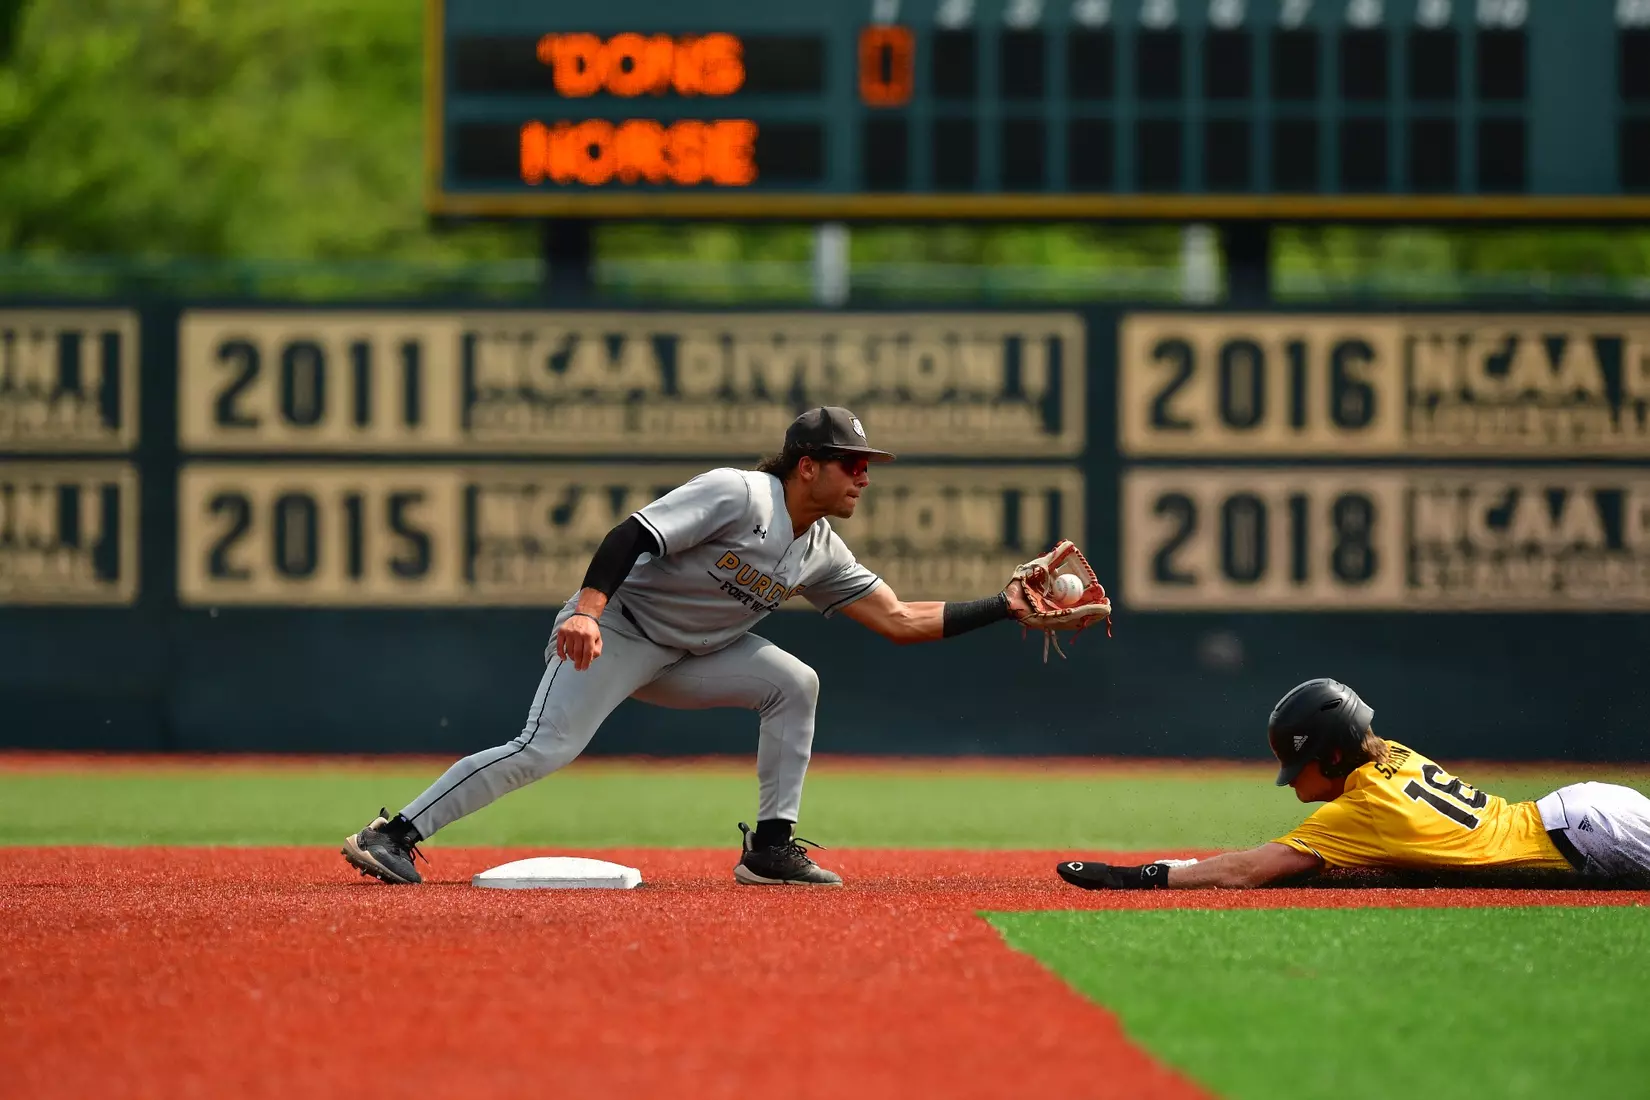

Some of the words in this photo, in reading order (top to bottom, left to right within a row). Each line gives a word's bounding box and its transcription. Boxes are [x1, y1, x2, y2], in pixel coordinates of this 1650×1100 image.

[859, 25, 914, 106] 0
[519, 118, 758, 186] NORSE
[212, 336, 424, 430] 2011
[474, 334, 666, 396] NCAA
[1148, 336, 1377, 433] 2016
[1411, 333, 1606, 397] NCAA
[207, 489, 433, 583] 2015
[1151, 491, 1379, 587] 2018
[1412, 487, 1607, 551] NCAA
[1403, 763, 1488, 830] 16
